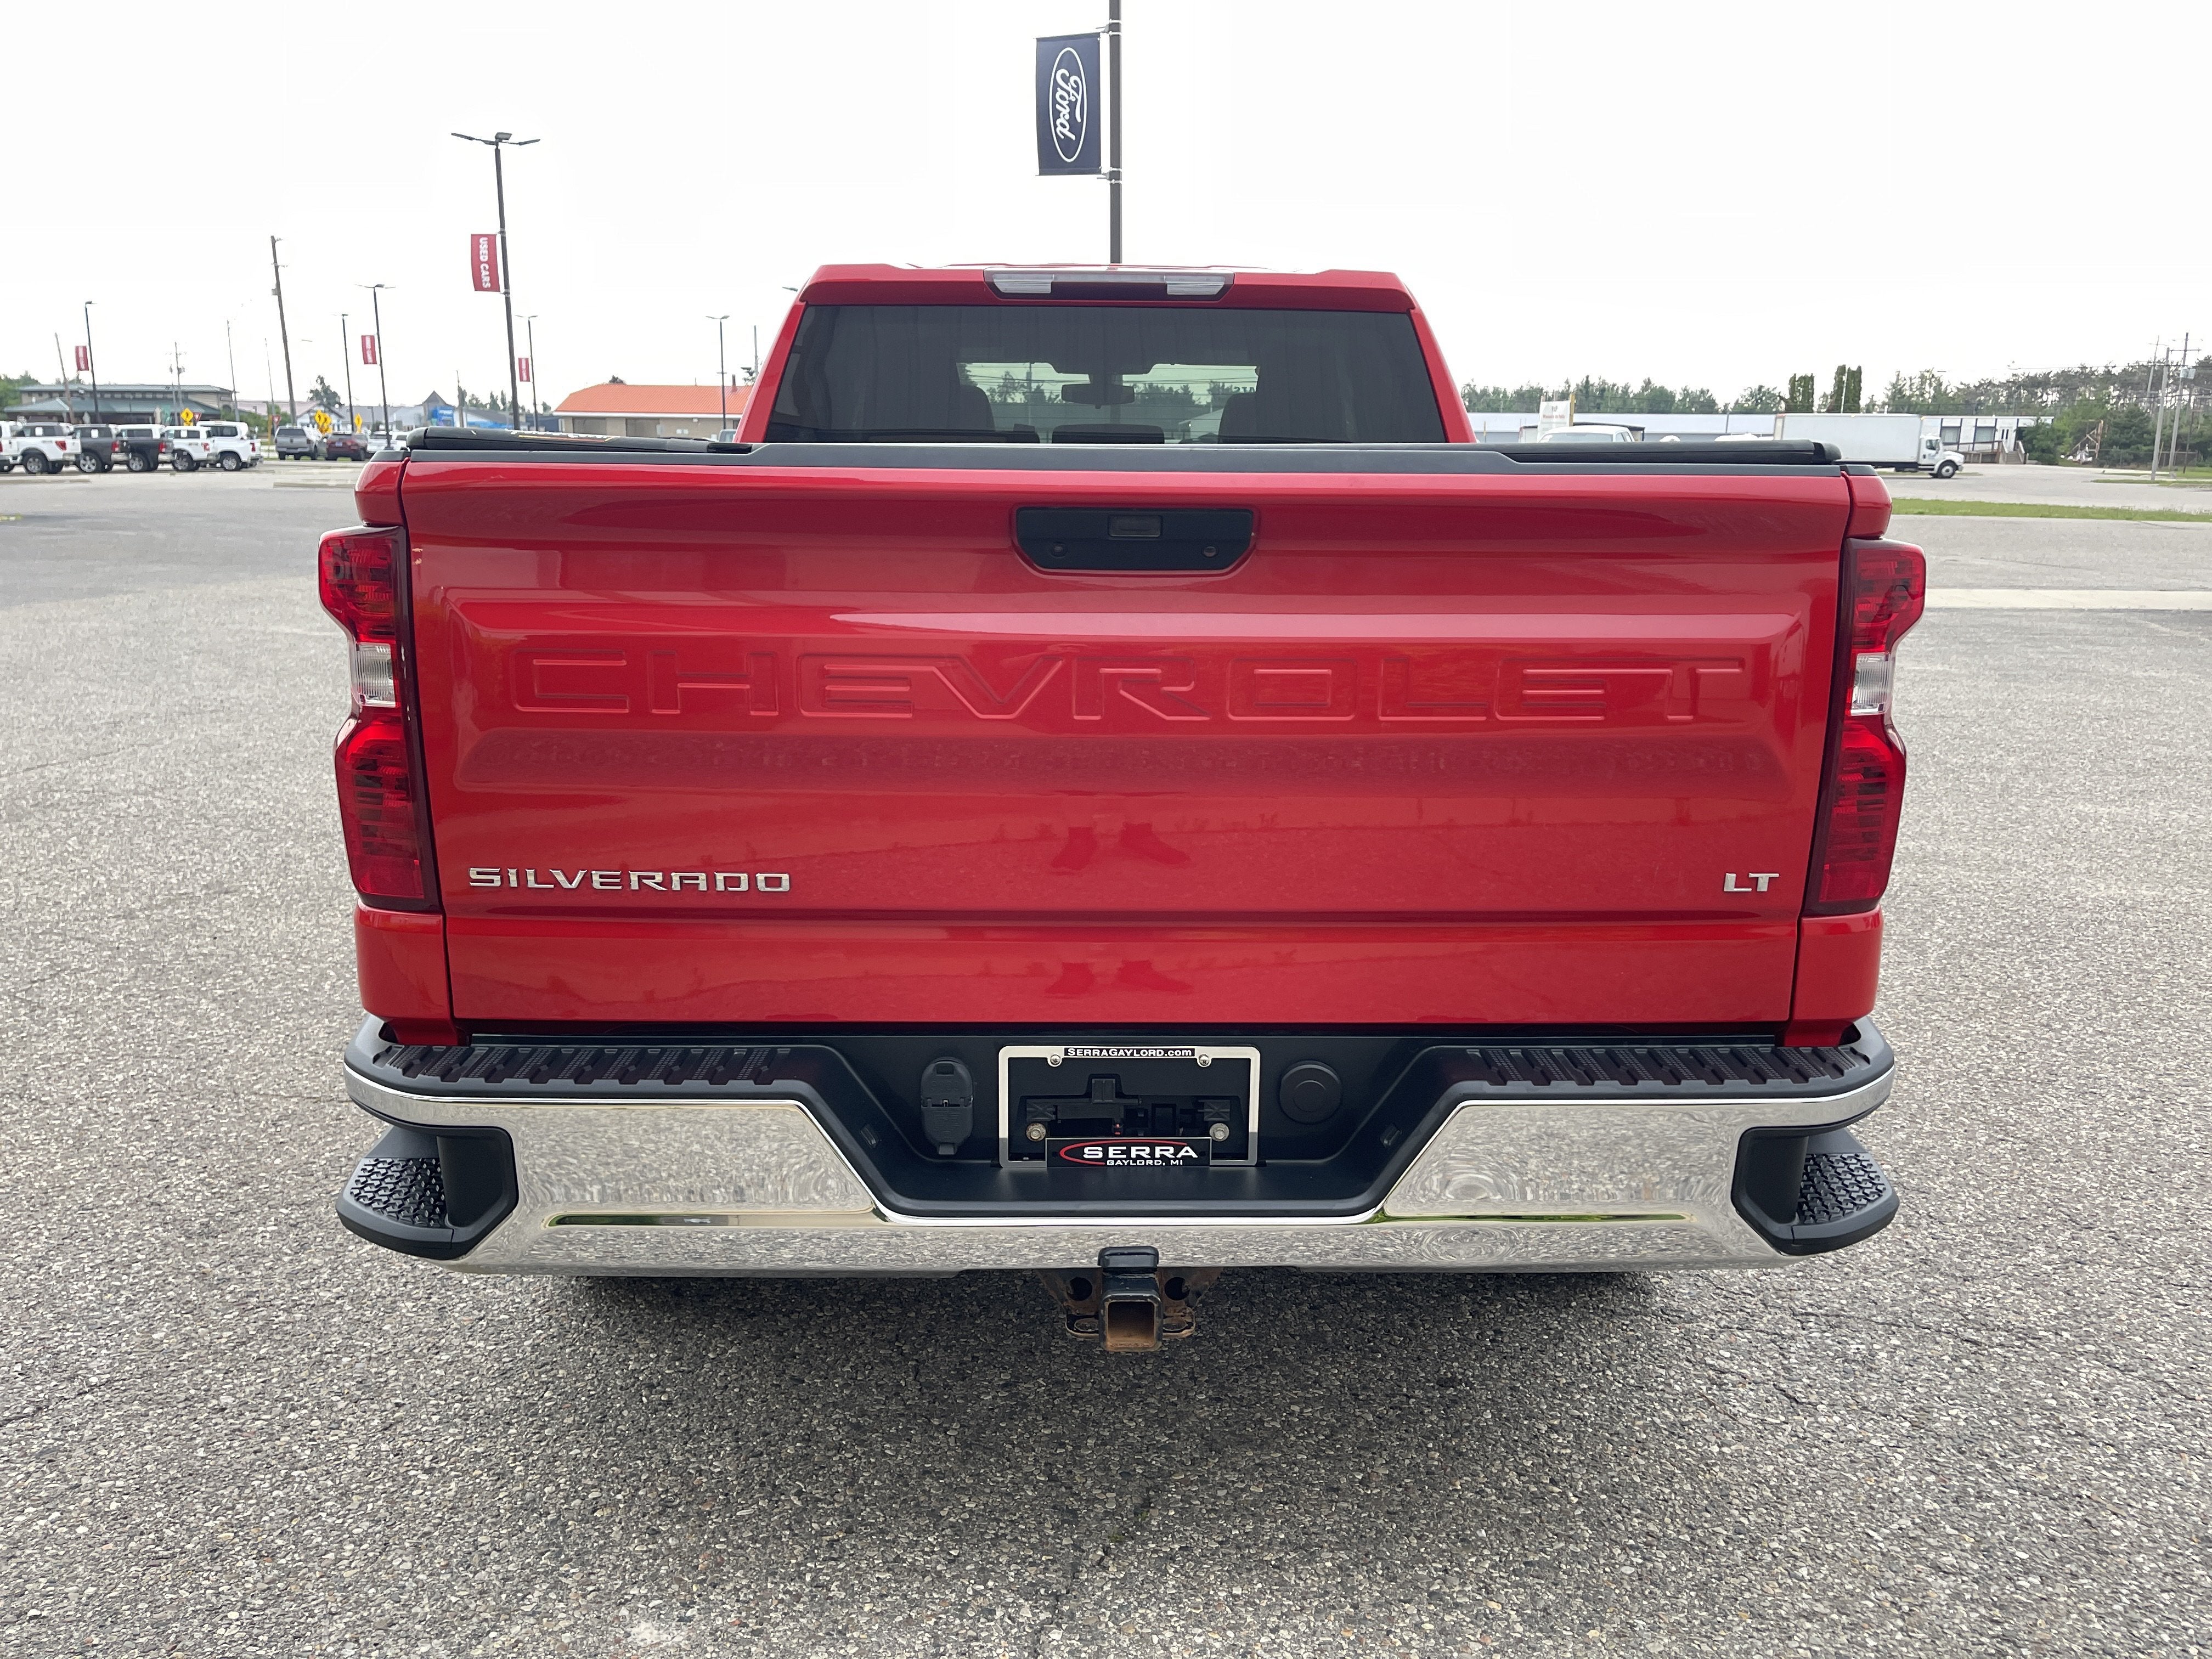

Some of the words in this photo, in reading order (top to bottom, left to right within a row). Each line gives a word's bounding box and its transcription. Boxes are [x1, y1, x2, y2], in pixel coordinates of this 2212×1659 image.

[1056, 69, 1082, 140] Ford
[479, 237, 488, 262] USED
[480, 263, 491, 289] CARS
[512, 648, 1745, 721] CHEVROLET
[469, 867, 791, 892] SILVERADO
[1723, 872, 1780, 892] LT
[1068, 1048, 1192, 1057] SERRAGAYLORD.com
[1083, 1146, 1198, 1159] SERRA
